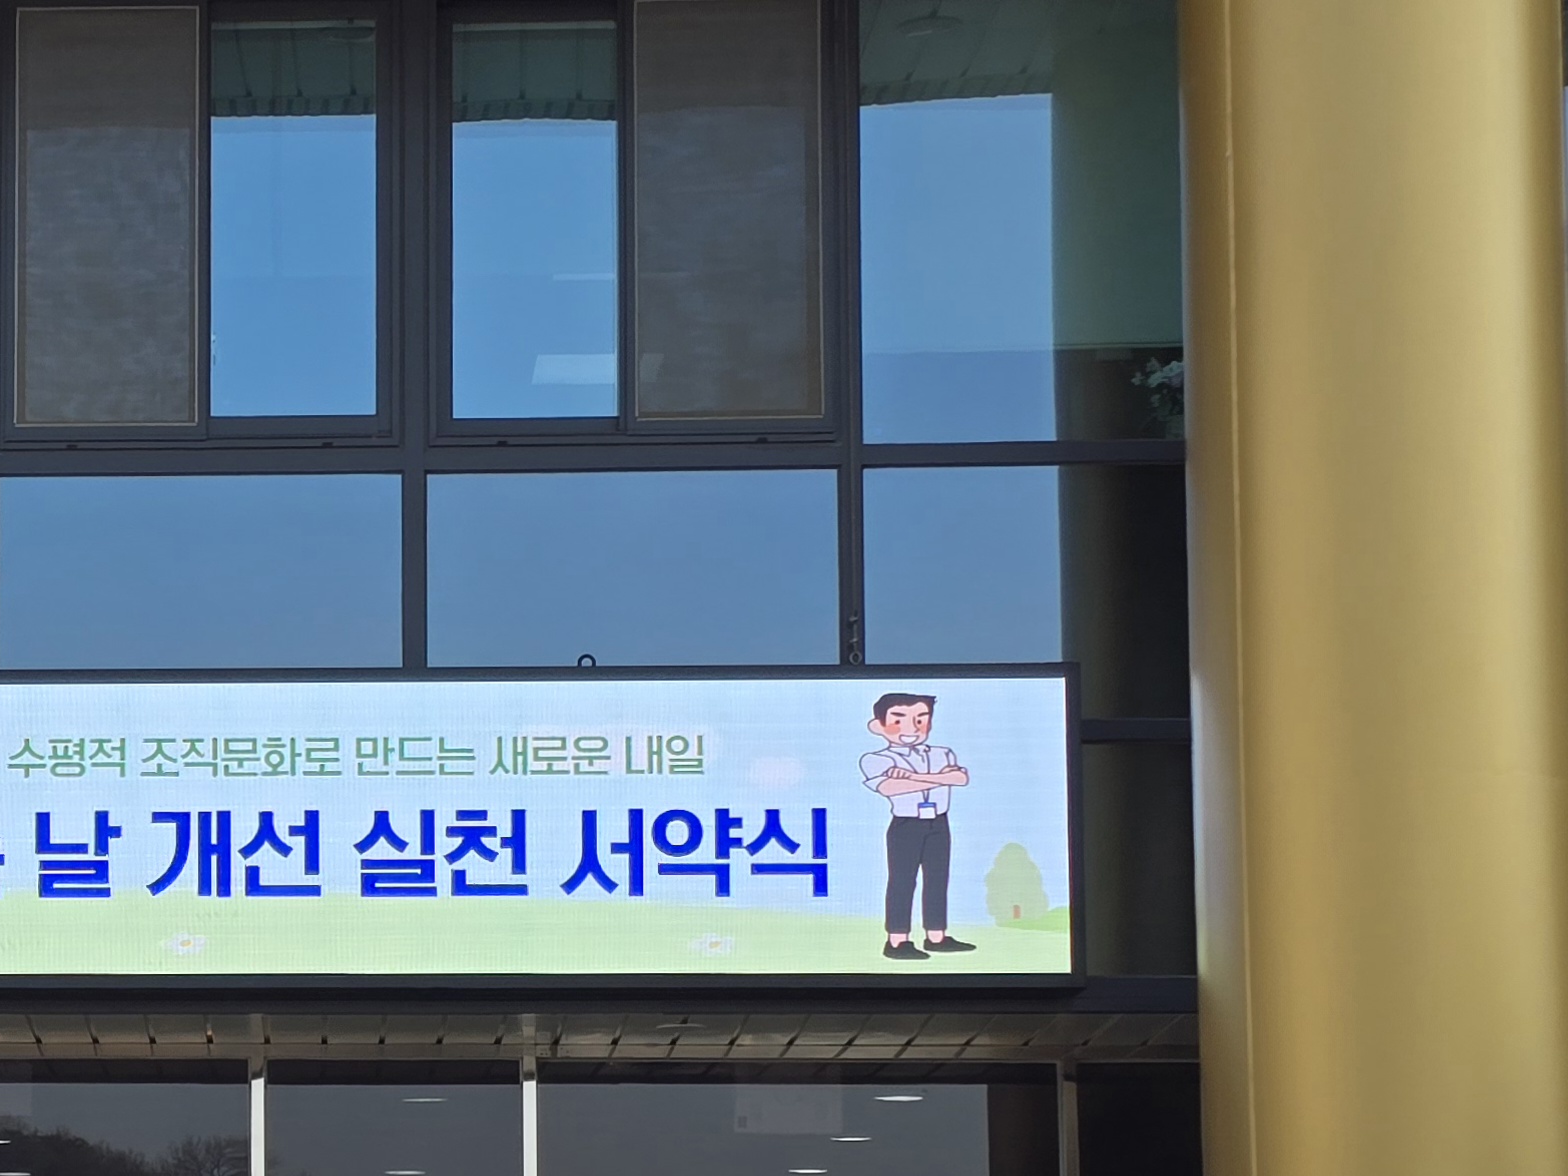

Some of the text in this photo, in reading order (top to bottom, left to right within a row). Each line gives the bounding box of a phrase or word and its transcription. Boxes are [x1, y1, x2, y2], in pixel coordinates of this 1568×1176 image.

[7, 737, 127, 778] 수평적
[140, 737, 342, 777] 조직문화로
[356, 736, 476, 777] 만드는
[489, 735, 611, 776] 새로운
[625, 735, 704, 775] 내일
[35, 810, 122, 898] 날
[146, 810, 321, 898] 개선
[353, 809, 529, 898] 실천
[560, 808, 828, 897] 서약식
